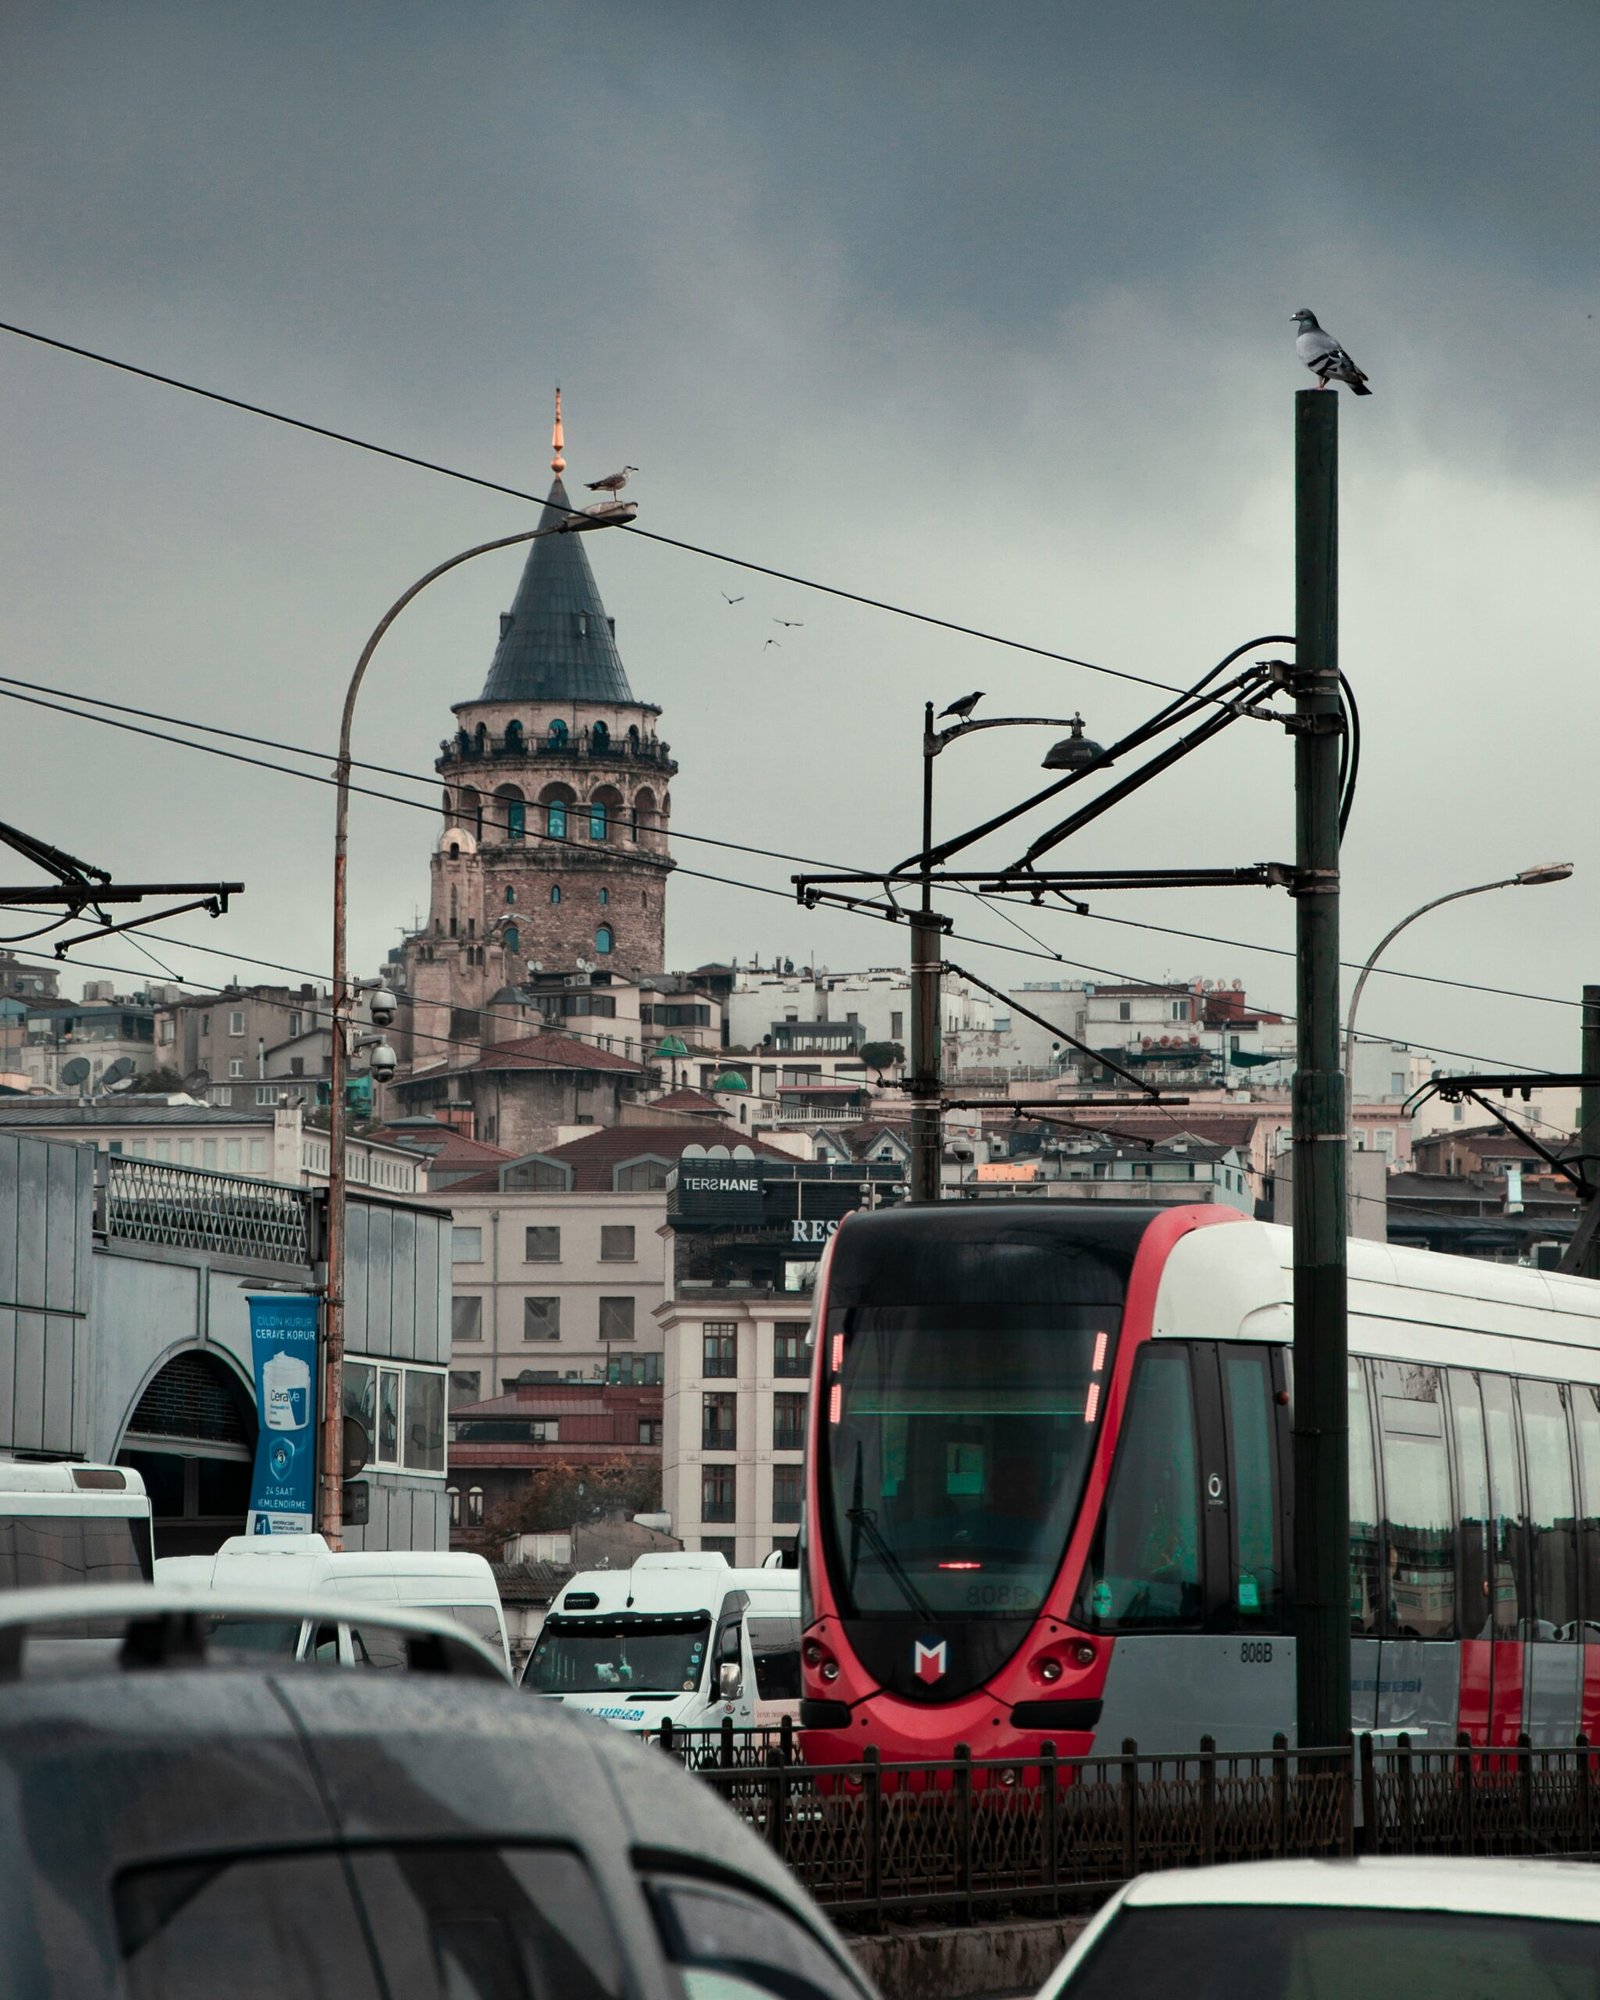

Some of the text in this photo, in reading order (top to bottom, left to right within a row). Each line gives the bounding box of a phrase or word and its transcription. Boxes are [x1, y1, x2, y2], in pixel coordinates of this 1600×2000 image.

[285, 1317, 313, 1328] KURUR
[286, 1329, 316, 1341] KORUR
[265, 1486, 274, 1495] 24
[1240, 1641, 1273, 1664] 808B
